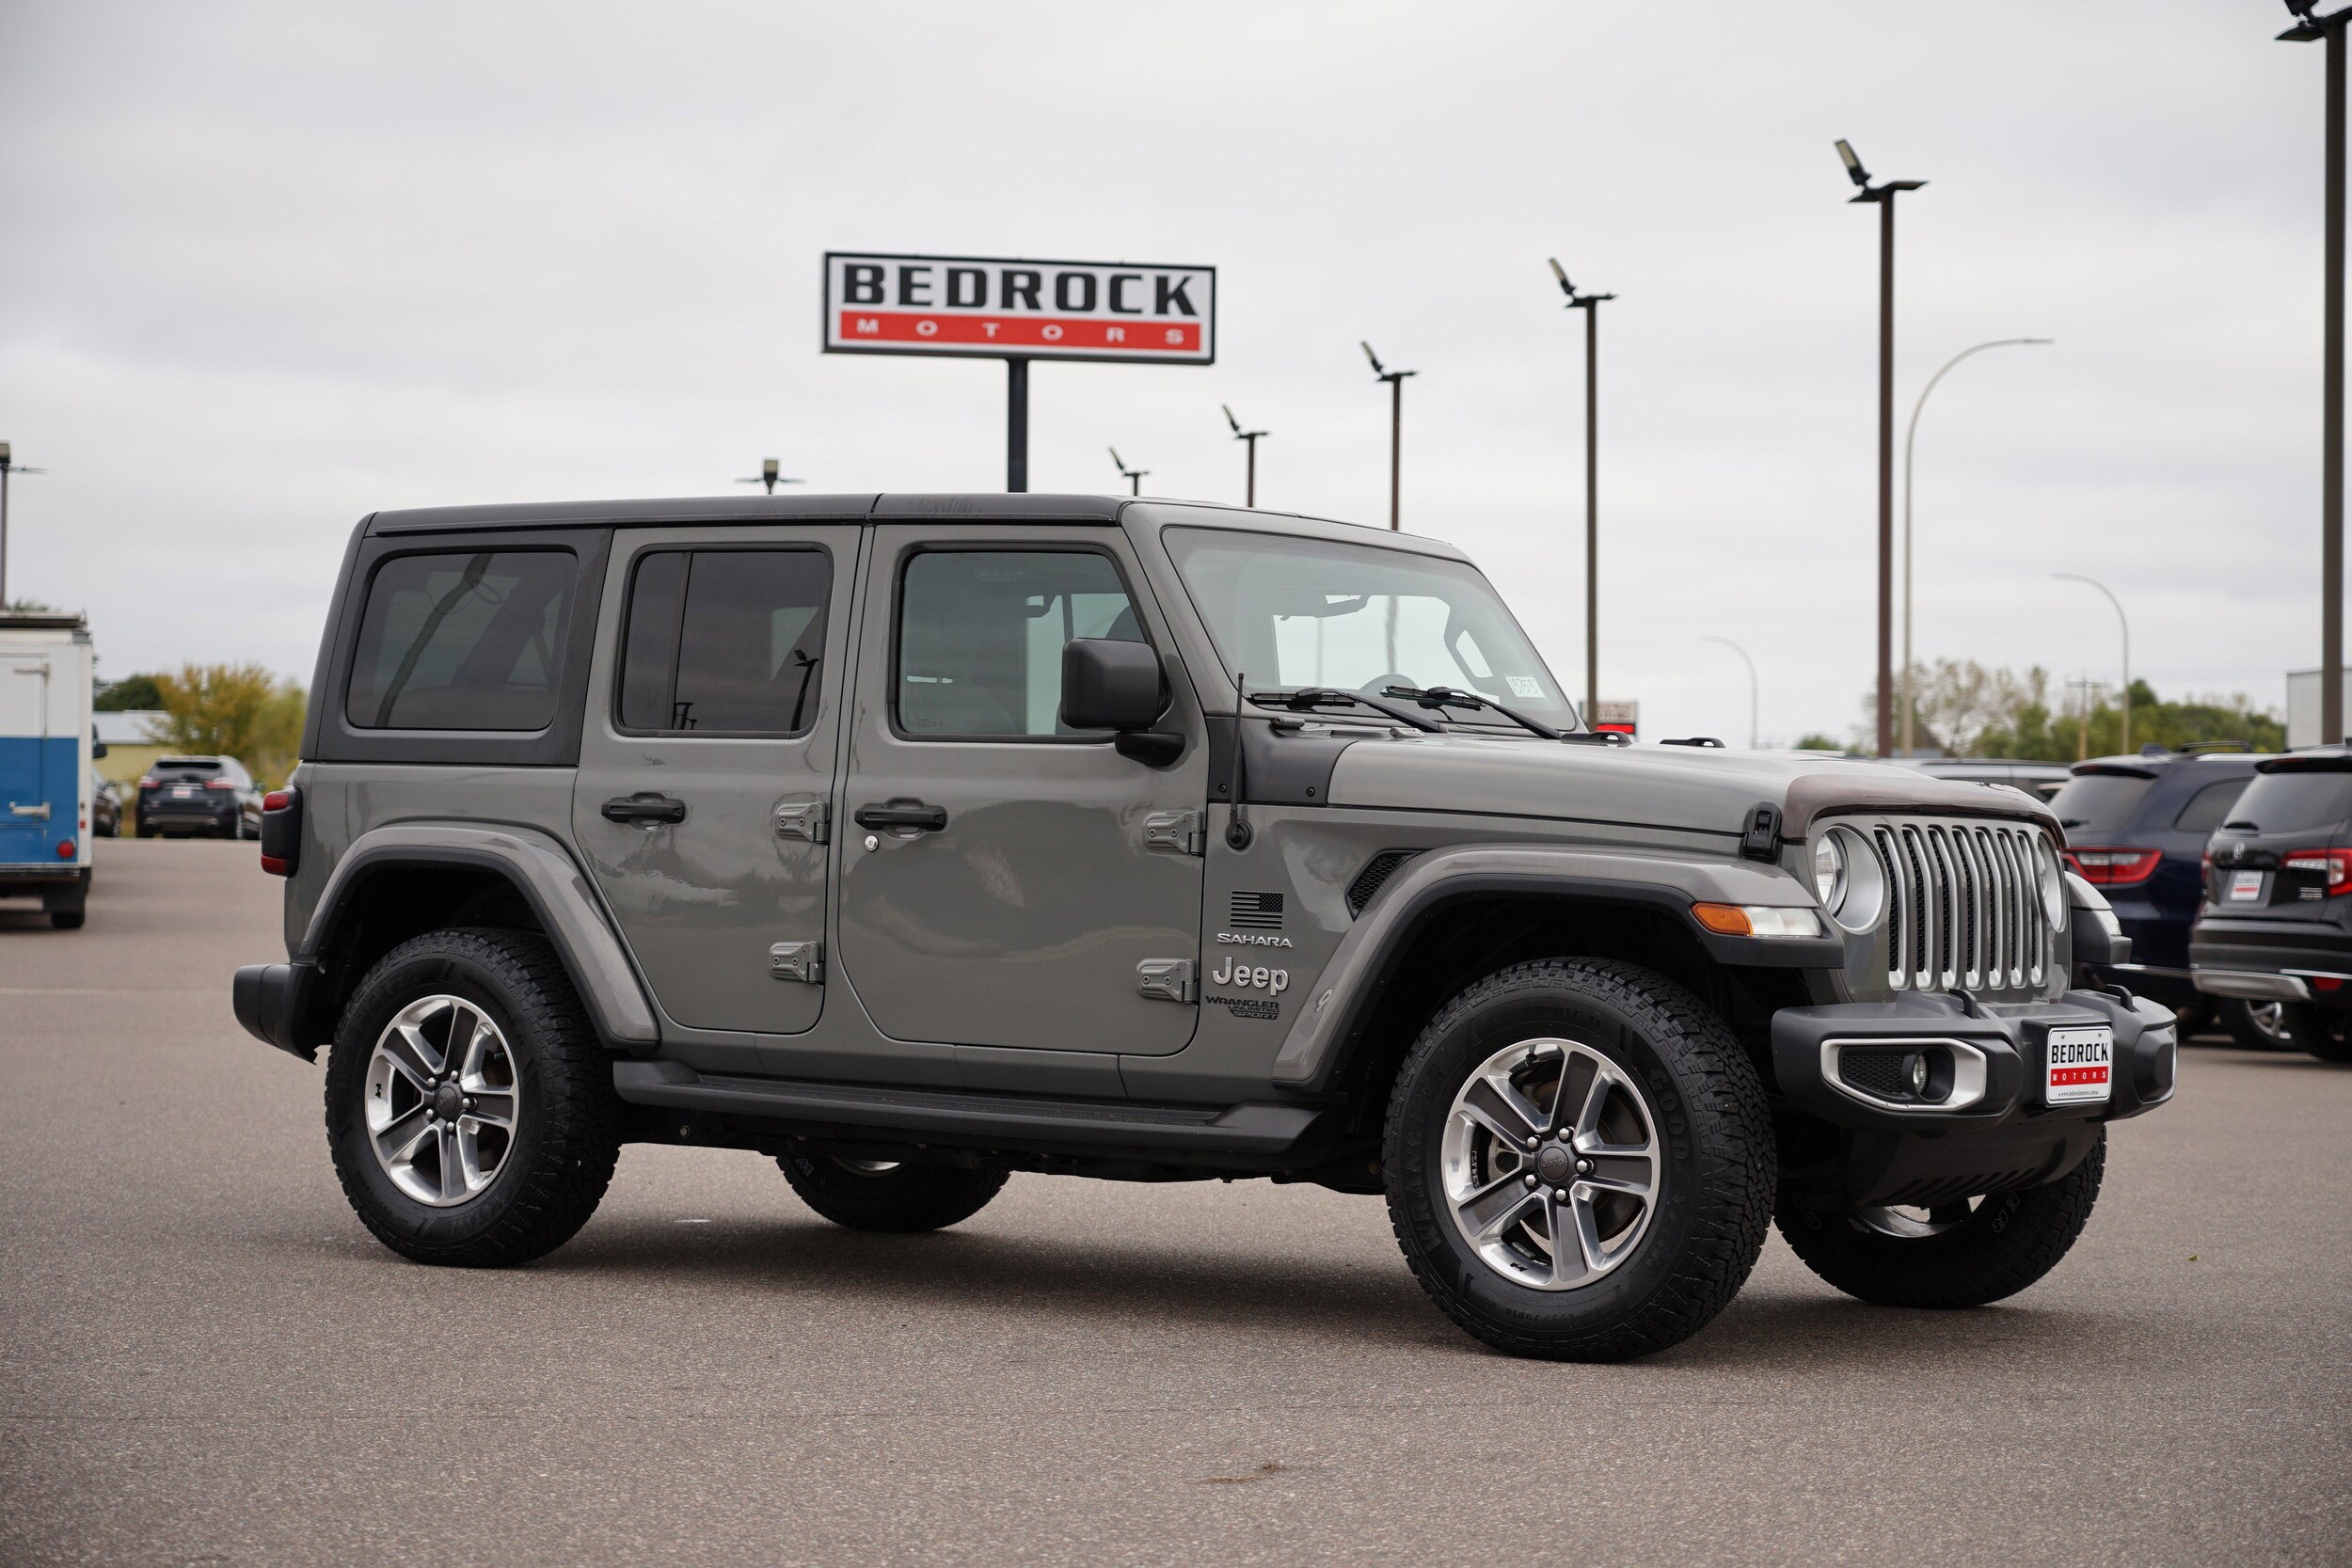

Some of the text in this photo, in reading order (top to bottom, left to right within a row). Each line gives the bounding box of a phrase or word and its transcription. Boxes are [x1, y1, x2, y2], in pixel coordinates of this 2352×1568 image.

[842, 263, 1199, 316] BEDROCK
[856, 318, 1184, 345] MOTORS
[1216, 932, 1294, 949] SAHARA
[1212, 956, 1289, 996] Jeep
[1205, 995, 1279, 1009] WRANGLER
[1228, 1005, 1280, 1013] UNLIMITED
[1232, 1010, 1278, 1020] SPORT
[2051, 1042, 2108, 1064] BEDROCK
[2052, 1070, 2106, 1082] MOTORS
